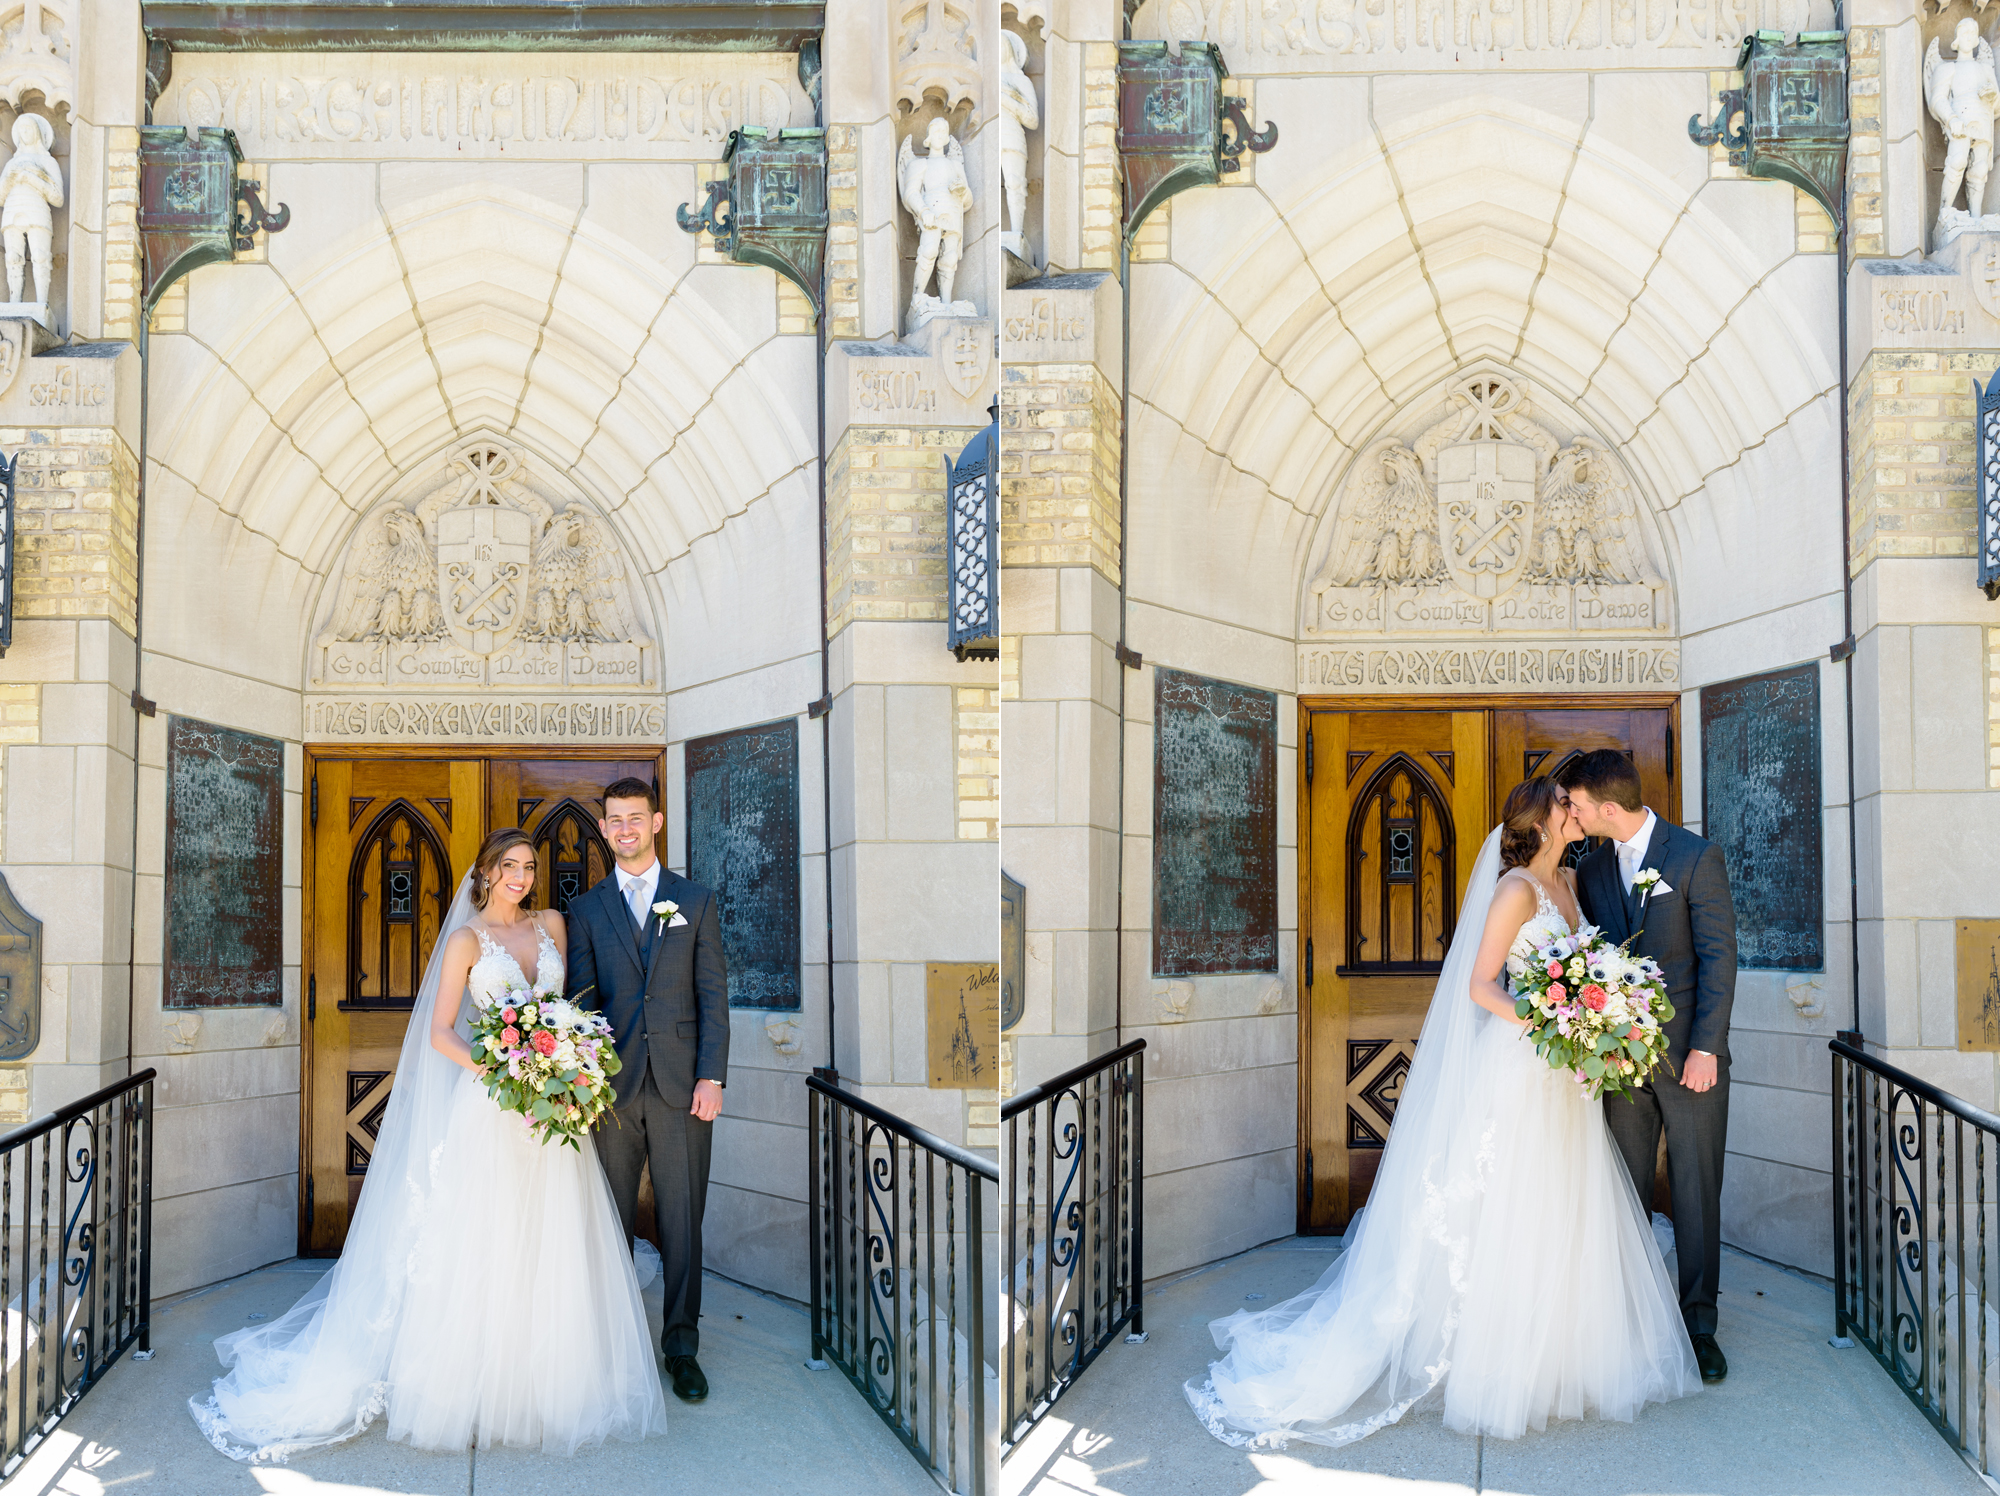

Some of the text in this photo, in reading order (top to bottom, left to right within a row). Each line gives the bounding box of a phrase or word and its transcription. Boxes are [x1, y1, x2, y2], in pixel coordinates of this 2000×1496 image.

[1326, 598, 1650, 625] God Country Notre Dame
[331, 653, 638, 679] God Country Notre Dame
